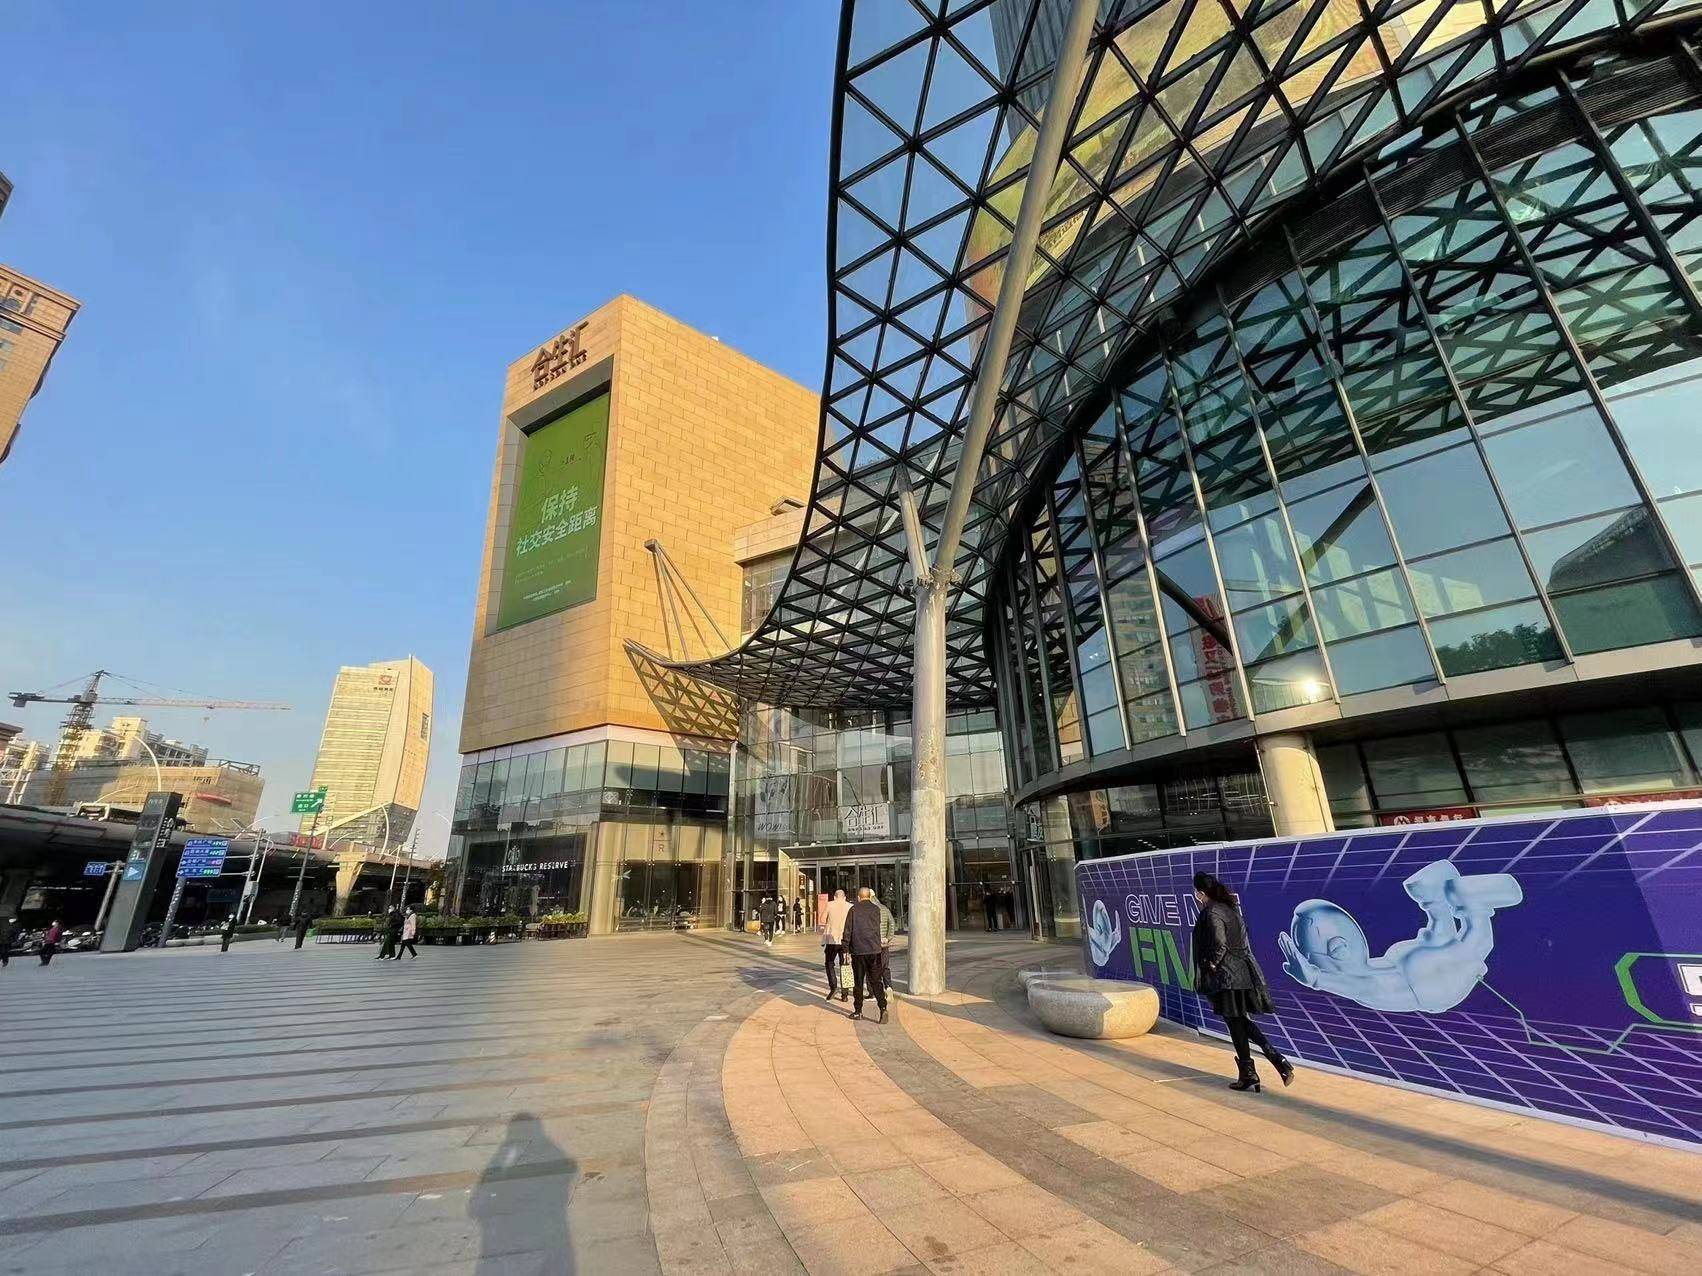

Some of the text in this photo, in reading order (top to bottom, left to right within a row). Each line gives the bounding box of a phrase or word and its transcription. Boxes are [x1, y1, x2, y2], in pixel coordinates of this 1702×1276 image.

[541, 485, 579, 523] 保持
[516, 506, 598, 557] 社交安全距离
[1125, 894, 1181, 926] GIVE
